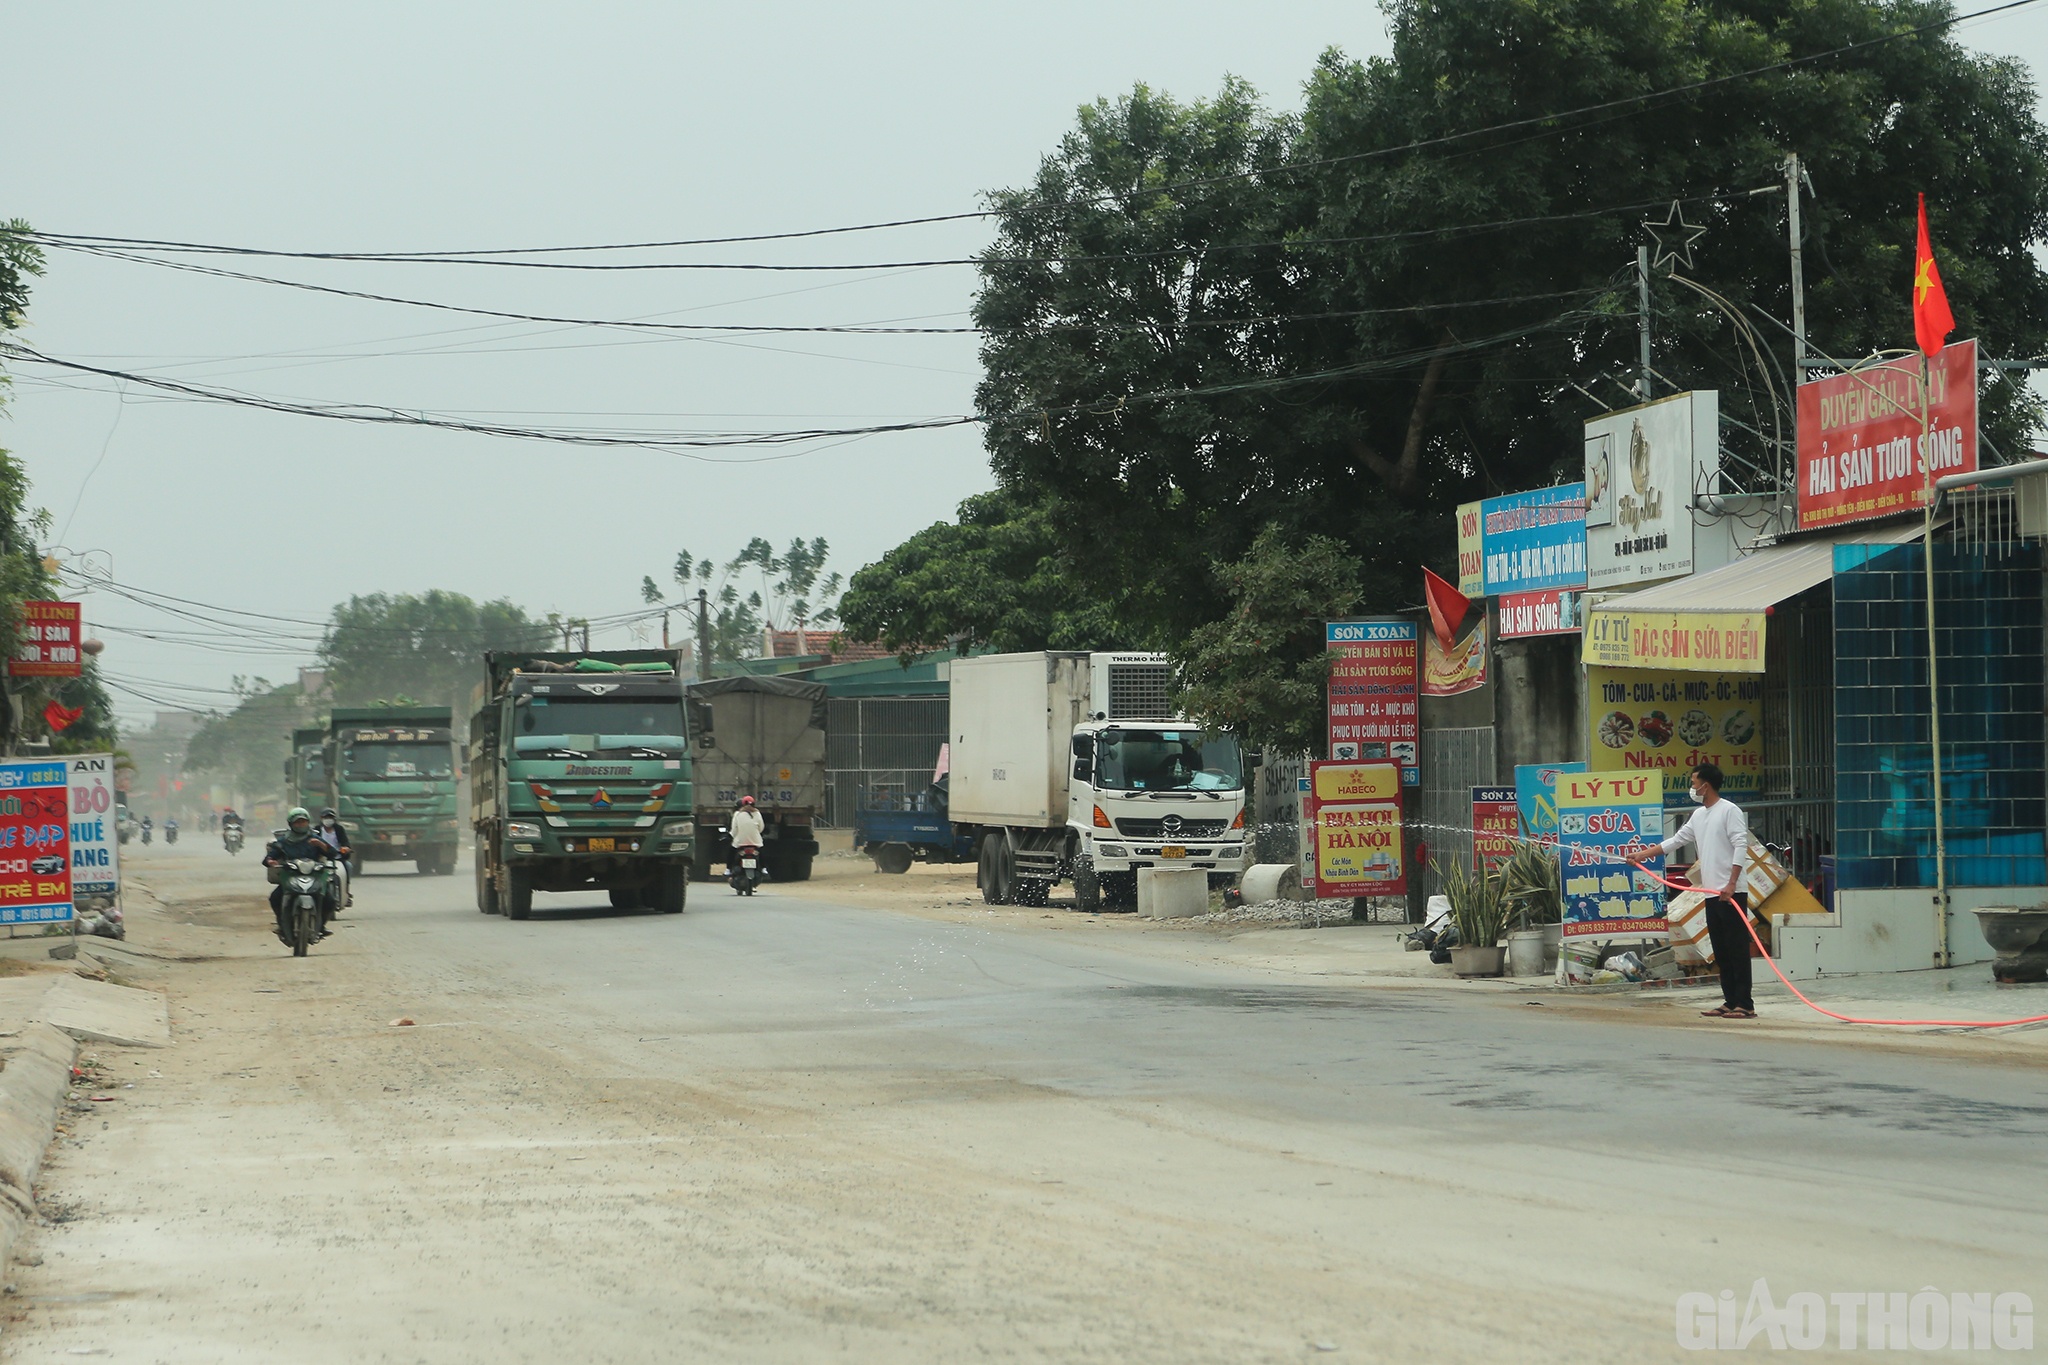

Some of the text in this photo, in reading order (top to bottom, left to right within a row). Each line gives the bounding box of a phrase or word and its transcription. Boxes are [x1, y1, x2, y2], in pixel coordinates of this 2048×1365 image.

[1820, 384, 1866, 430] DUYÊN
[1868, 370, 1896, 419] GẤU
[1928, 359, 1947, 405] LÝ
[1809, 416, 1962, 496] HẢI SẢN TƯƠI SỐNG
[1460, 510, 1482, 577] SƠN XOAN
[42, 607, 76, 620] LINH
[1500, 594, 1558, 634] HẢI SẢN SỐNG
[45, 622, 70, 642] SẢN
[1334, 625, 1410, 640] SƠN XOAN
[1594, 614, 1630, 642] LÝ TỨ
[1634, 618, 1758, 663] ĐẶC SẢN SỨA BIỂN
[50, 644, 76, 662] KHÔ
[1365, 645, 1380, 658] BÁN
[1383, 644, 1390, 657] SỈ
[1392, 644, 1403, 657] VÀ
[1405, 643, 1415, 657] LẺ
[1333, 661, 1412, 677] HẢI SẢN TƯƠI SỐNG
[1332, 681, 1346, 696] HẢI
[1348, 681, 1364, 695] SẢN
[1392, 683, 1415, 697] LẠNH
[1602, 680, 1626, 703] TÔM
[1633, 683, 1655, 702] CUA
[1662, 679, 1677, 702] CÁ
[1684, 680, 1709, 705] MỰC
[1716, 675, 1731, 701] ỐC
[1332, 700, 1415, 718] HÀNG TÔM CÁ MỰC KHÔ
[1332, 726, 1350, 740] PHỤC
[1352, 726, 1361, 740] VỤ
[1379, 720, 1390, 737] HỎI
[1392, 720, 1400, 737] LỄ
[1400, 724, 1415, 740] TIỆC
[74, 760, 105, 772] AN
[566, 764, 633, 776] BRIDGESTONE
[1402, 771, 1415, 782] 66
[1722, 772, 1750, 788] HUYÊN
[1338, 786, 1376, 794] HABECO
[1481, 790, 1503, 800] SƠN
[1571, 776, 1648, 798] LÝ TỨ
[73, 778, 110, 814] BÒ
[1499, 804, 1517, 812] CHUYÊ
[1325, 812, 1355, 828] BIA
[1483, 813, 1506, 830] HẢI
[1588, 809, 1635, 834] SỨA
[70, 816, 104, 842] HUẾ
[22, 824, 65, 852] ĐẠP
[1327, 830, 1356, 848] HÀ
[1358, 829, 1392, 851] NỘI
[1475, 837, 1506, 852] TƯƠI
[1568, 841, 1600, 867] ĂN
[1606, 836, 1658, 865] LIỀN
[1332, 857, 1341, 866] Các
[1325, 867, 1359, 878] Nhậu Bình Dân
[38, 882, 66, 896] EM
[1578, 924, 1593, 933] 0975
[1594, 924, 1604, 932] 835
[1606, 923, 1617, 931] 772
[1622, 921, 1665, 931] 0347049048
